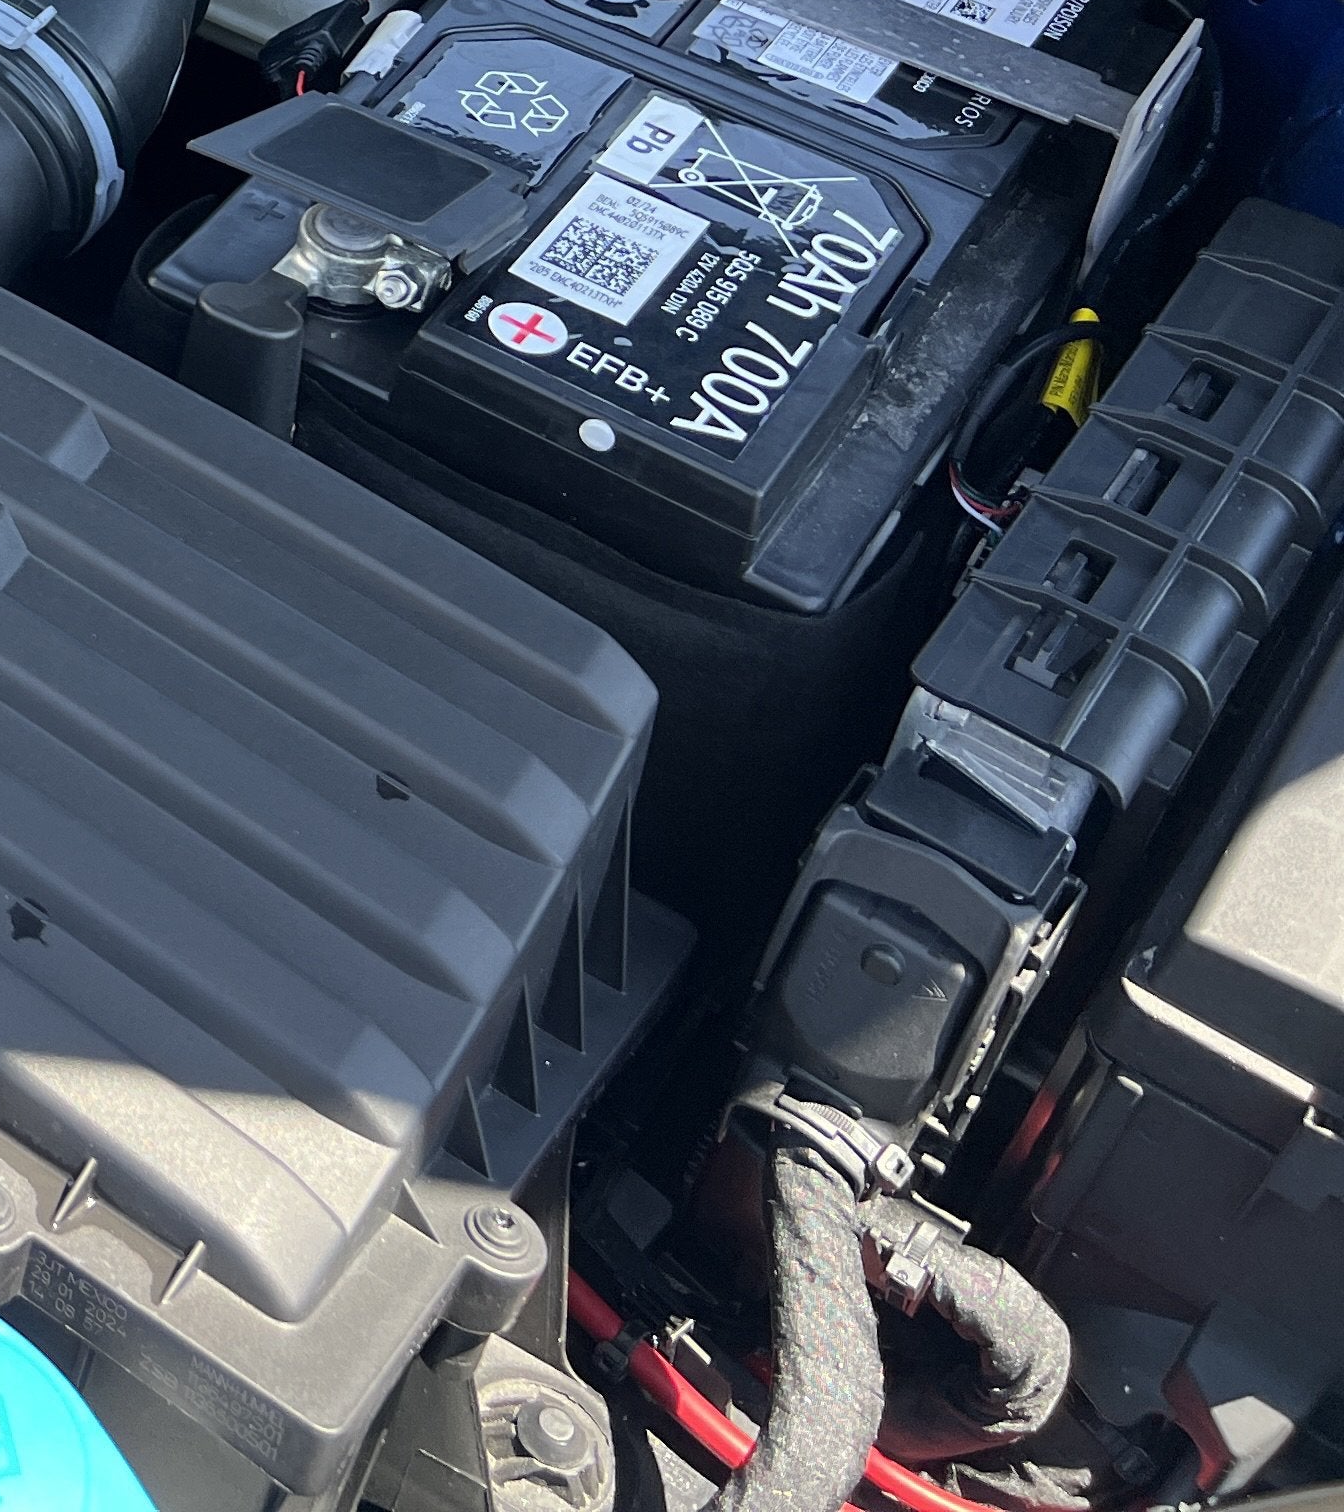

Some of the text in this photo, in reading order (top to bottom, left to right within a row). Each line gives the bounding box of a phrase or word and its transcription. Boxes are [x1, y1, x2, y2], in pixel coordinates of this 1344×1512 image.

[954, 94, 992, 127] RIOS
[624, 120, 676, 160] Pb
[624, 194, 657, 215] 02/24
[767, 210, 896, 317] 70Ah
[661, 254, 721, 318] 12V 420A DIN
[709, 277, 738, 303] 915
[675, 324, 697, 342] C
[690, 299, 719, 328] 089
[566, 341, 670, 402] EFB+
[670, 321, 812, 441] 700A
[31, 1267, 129, 1338] 29 01 2024
[64, 1271, 129, 1320] MEXICO
